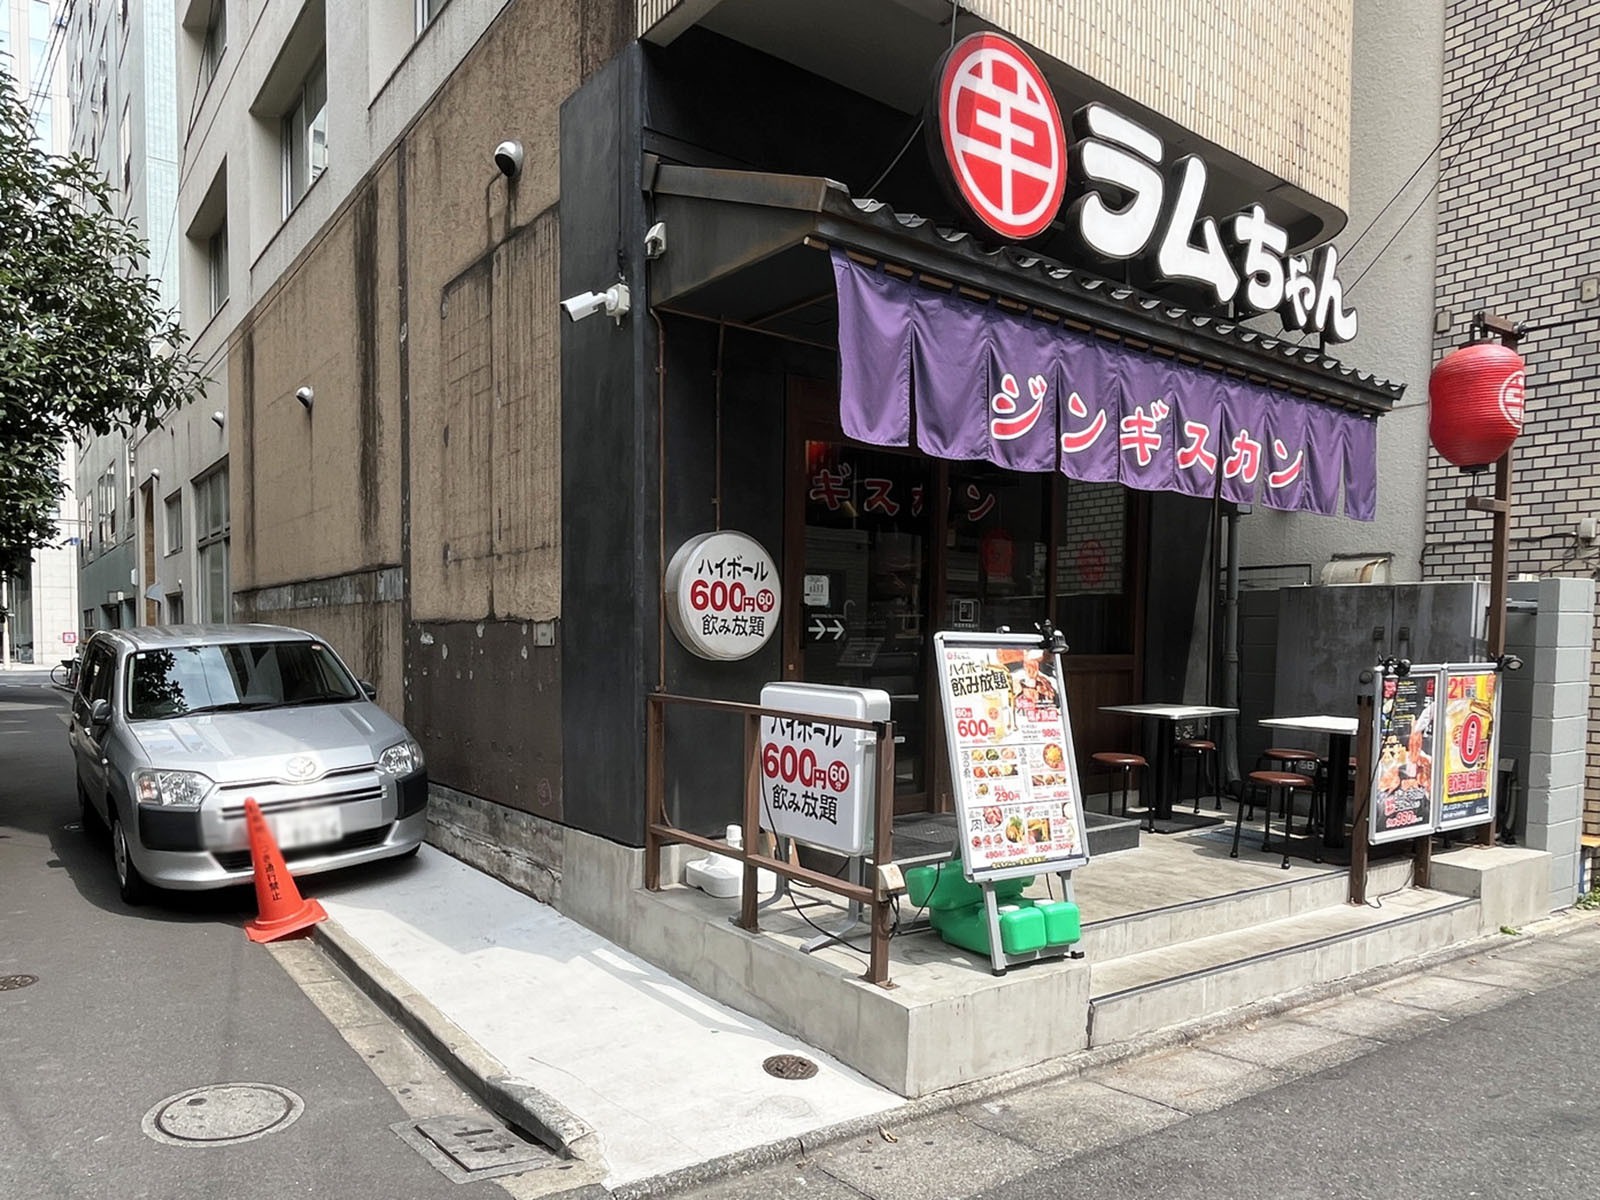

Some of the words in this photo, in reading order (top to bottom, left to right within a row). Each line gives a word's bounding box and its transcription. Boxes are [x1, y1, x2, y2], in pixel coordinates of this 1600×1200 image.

[1080, 103, 1358, 341] ラムちゃん
[991, 374, 1304, 489] ジンギスカン
[697, 553, 769, 582] ハイボール
[690, 579, 756, 613] 600円
[702, 614, 766, 638] 飲み放題
[950, 670, 1010, 697] 飲み放題
[957, 719, 997, 738] 600円
[763, 743, 827, 790] 600円
[772, 783, 838, 825] 飲み放題
